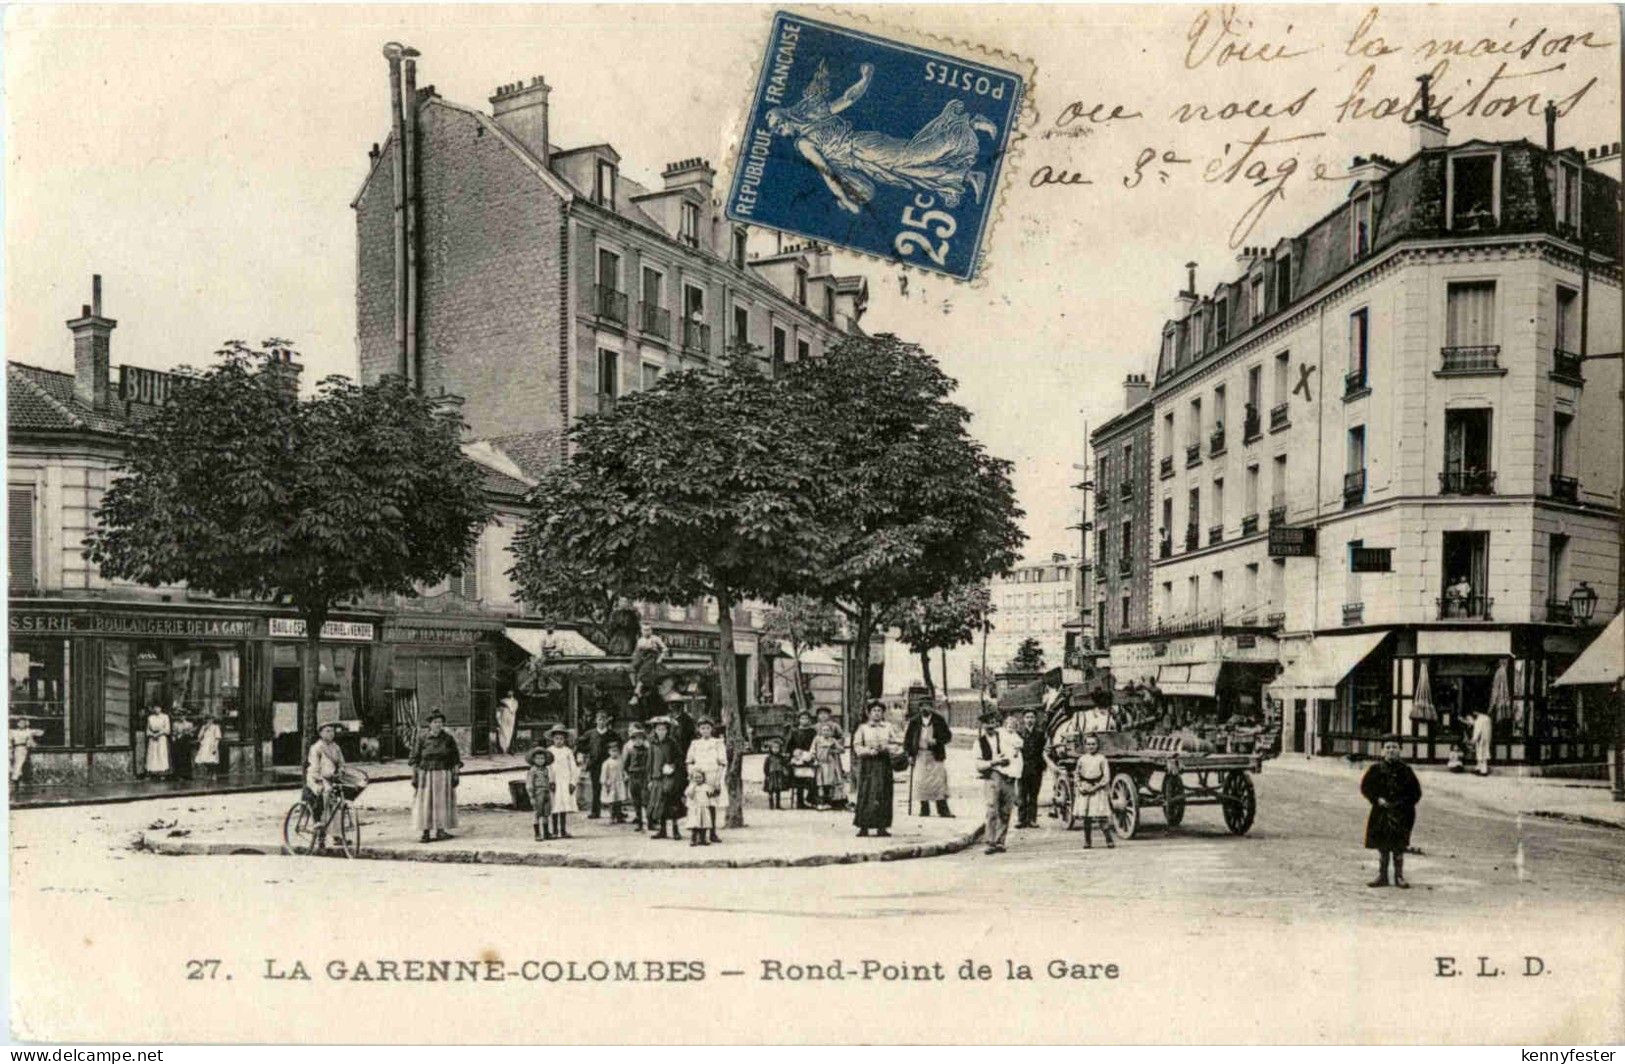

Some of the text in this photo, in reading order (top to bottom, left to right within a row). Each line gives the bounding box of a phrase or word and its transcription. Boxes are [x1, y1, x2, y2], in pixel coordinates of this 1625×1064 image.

[1345, 6, 1400, 57] la
[1414, 18, 1612, 59] maison
[925, 61, 1005, 101] POSTES
[1170, 87, 1317, 124] nous
[1337, 59, 1598, 124] habitons
[736, 128, 773, 216] REPUBLIQUE
[1029, 165, 1093, 189] au
[204, 621, 219, 636] LA
